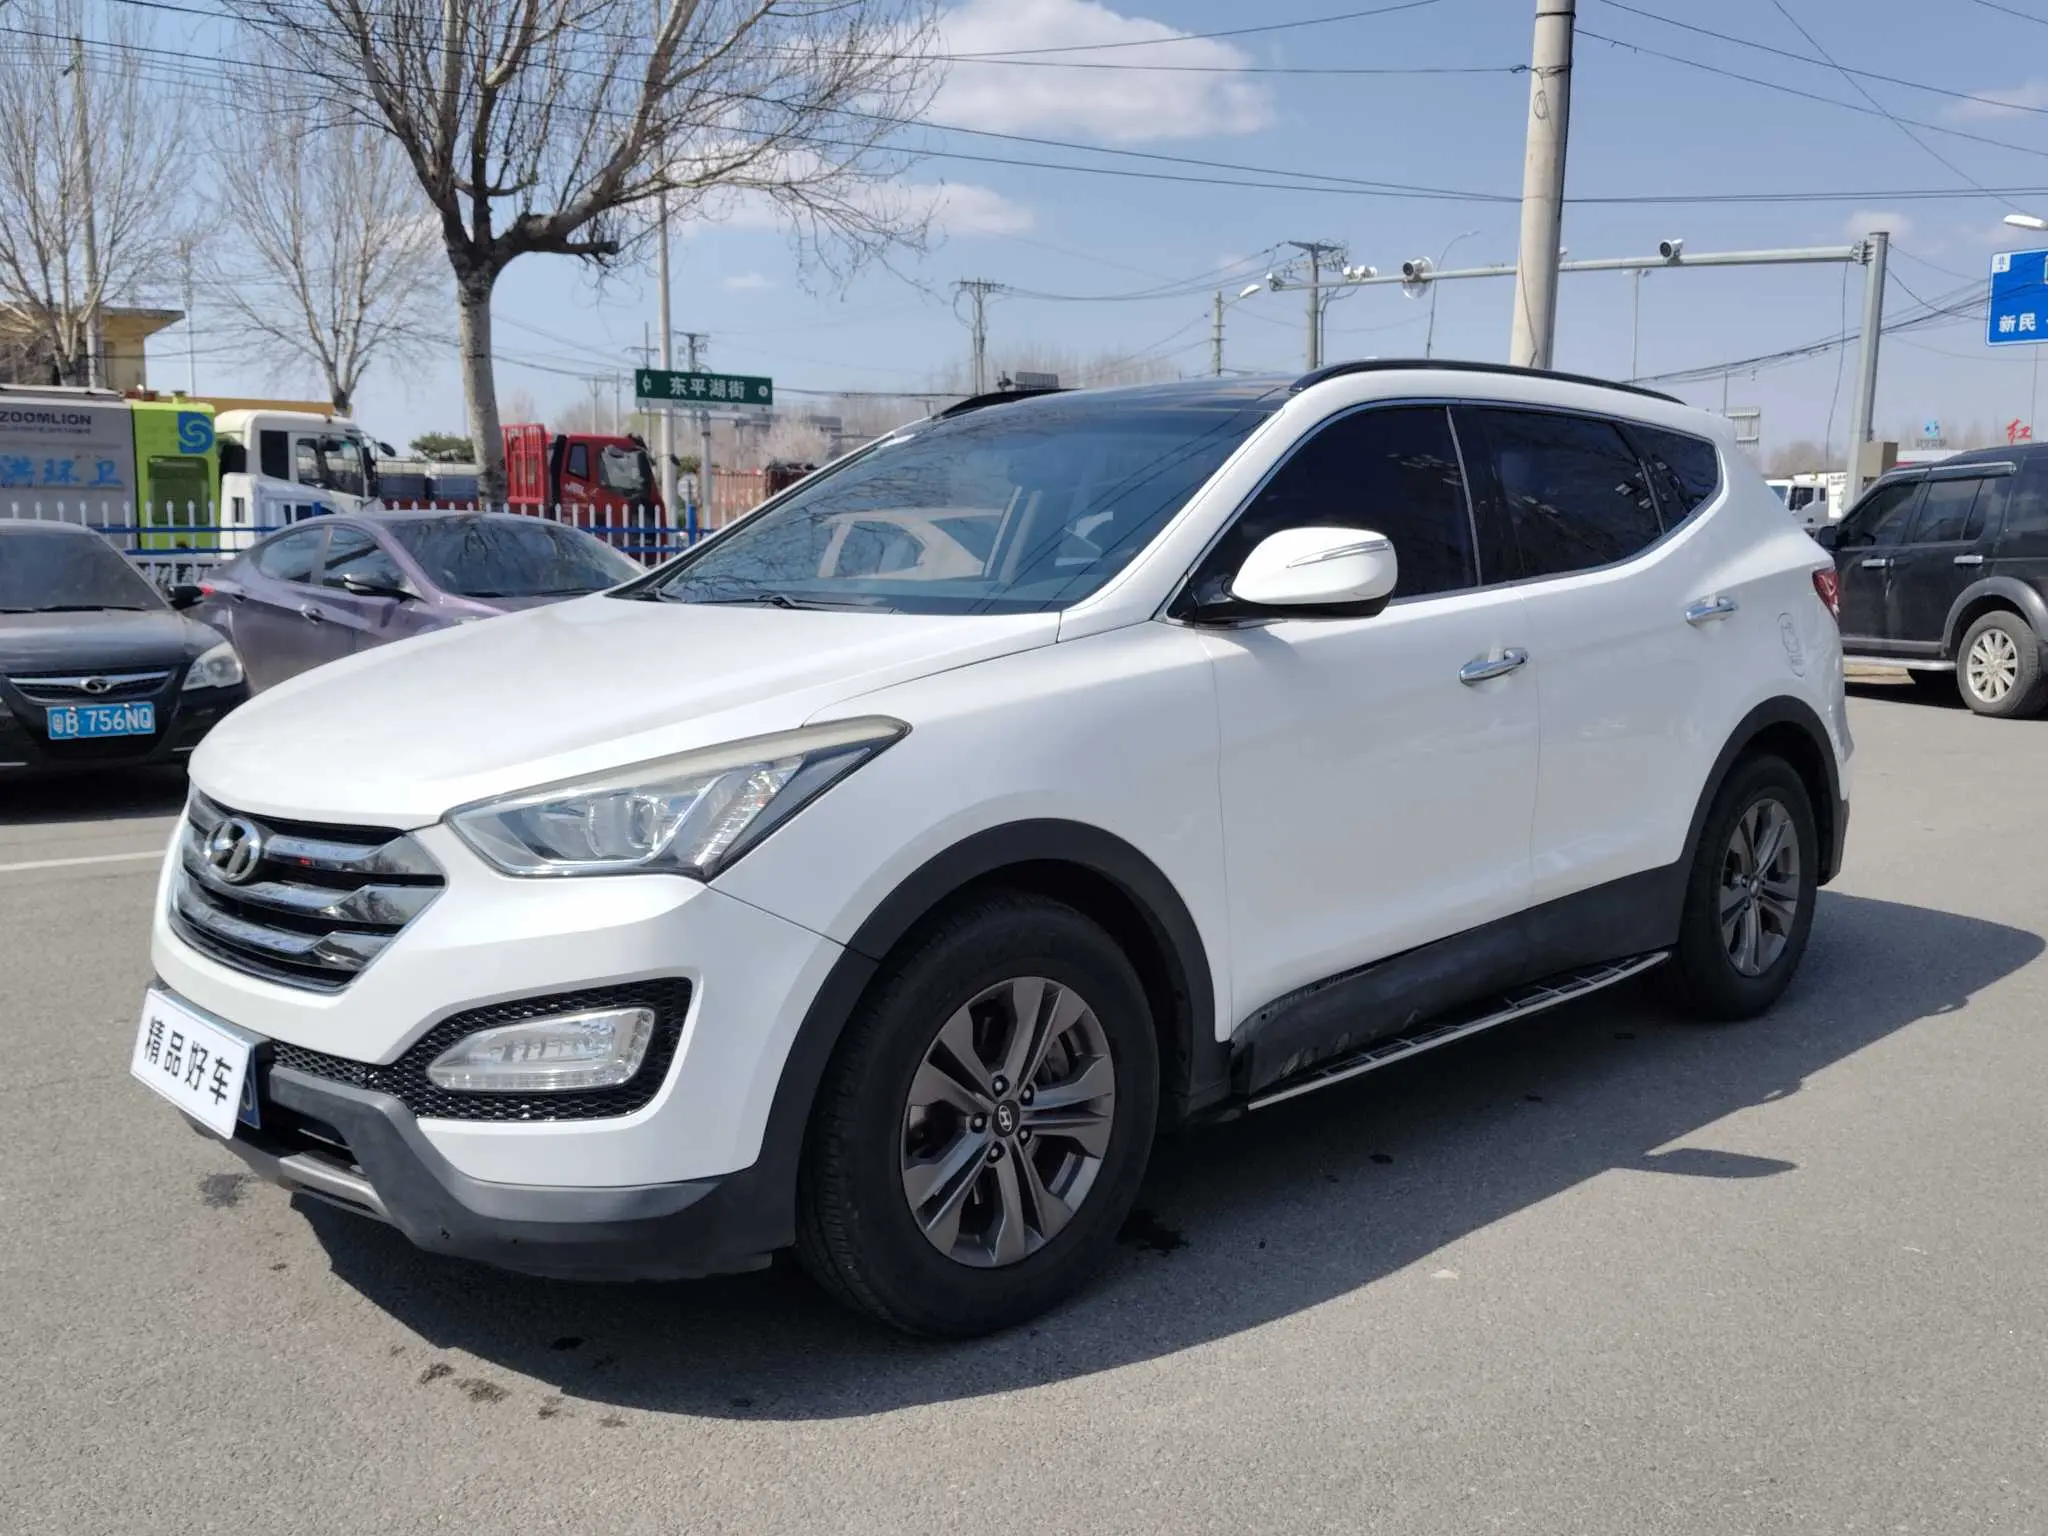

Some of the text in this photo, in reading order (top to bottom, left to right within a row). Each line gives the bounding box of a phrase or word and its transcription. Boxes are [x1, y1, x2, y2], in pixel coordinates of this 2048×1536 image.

[1999, 312, 2036, 333] 新民
[669, 376, 745, 400] 东平湖街
[0, 411, 91, 425] ZOOMLION
[144, 1016, 233, 1105] 精品好车
